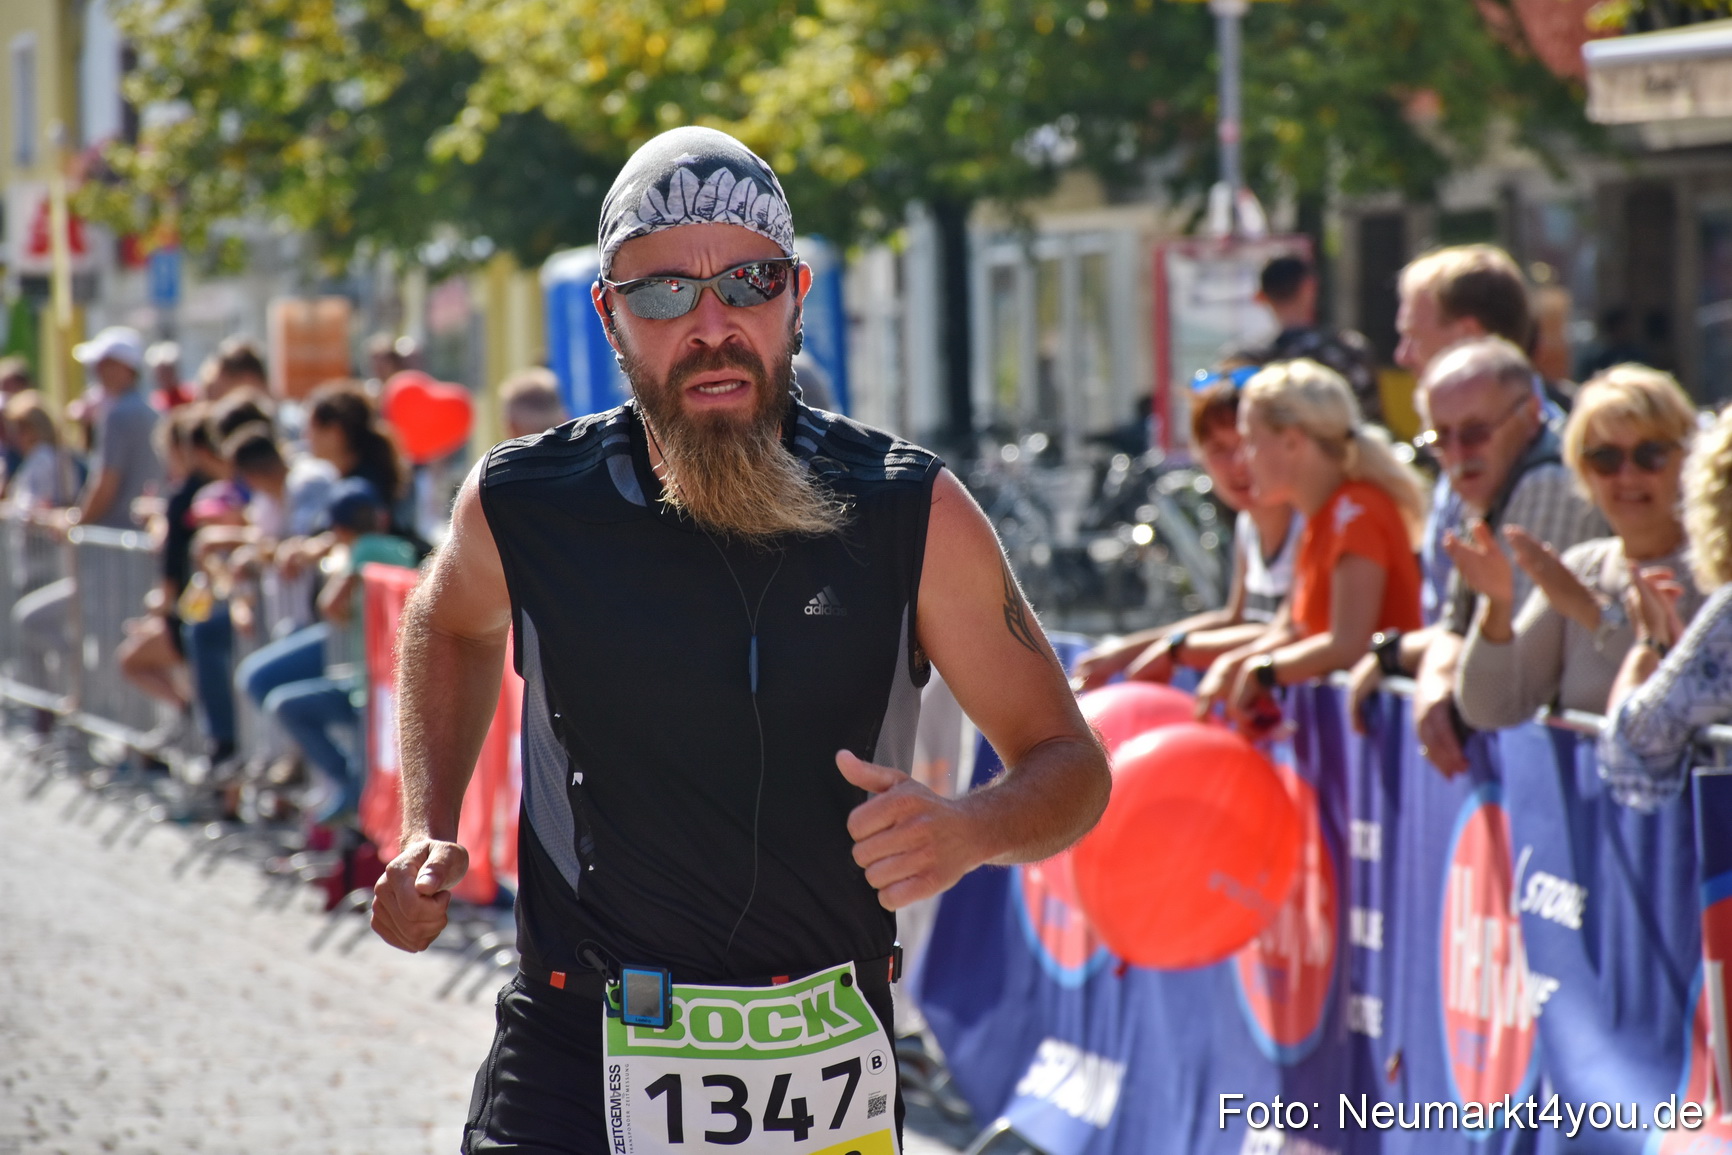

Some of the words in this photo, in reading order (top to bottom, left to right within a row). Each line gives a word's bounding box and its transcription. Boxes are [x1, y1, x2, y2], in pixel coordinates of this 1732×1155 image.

[804, 603, 848, 616] adidas
[871, 1055, 883, 1070] B
[645, 1057, 862, 1145] 1347
[625, 1111, 635, 1154] TRANSPONDER
